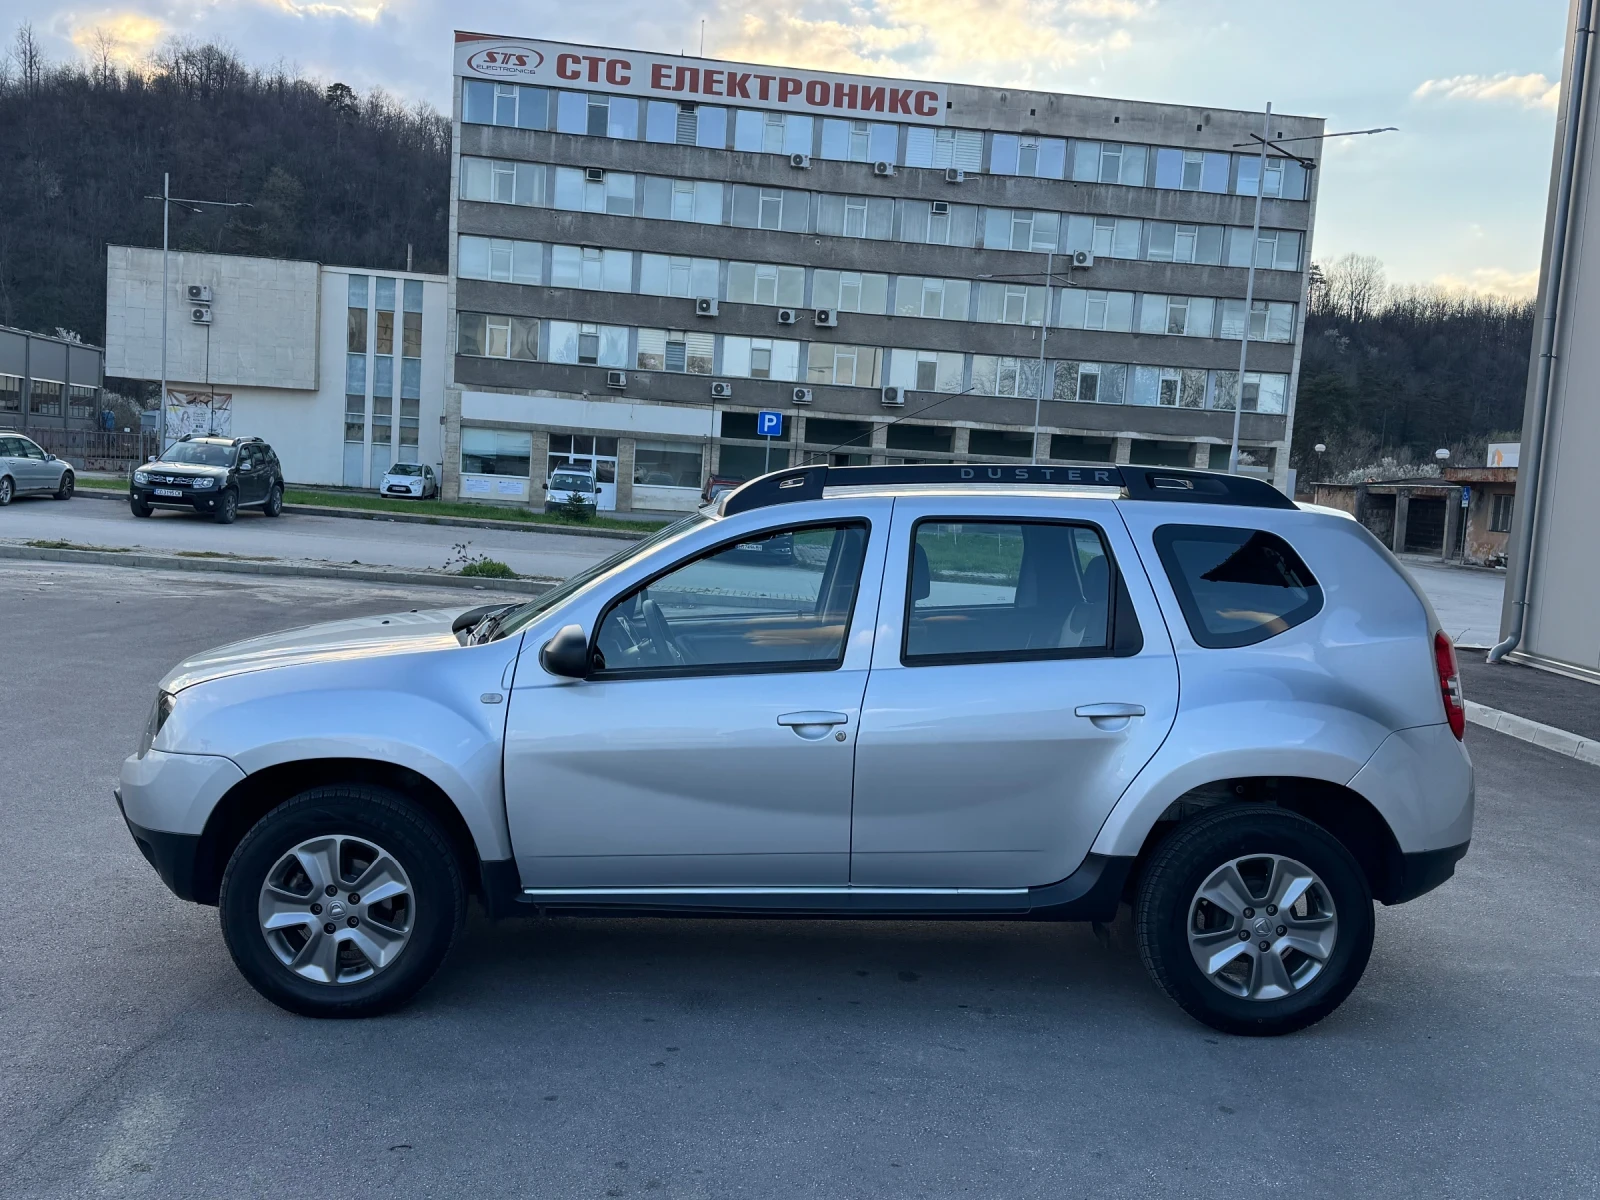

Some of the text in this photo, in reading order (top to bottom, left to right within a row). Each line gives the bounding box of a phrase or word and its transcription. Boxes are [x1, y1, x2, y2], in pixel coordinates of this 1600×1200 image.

[483, 51, 529, 66] STS
[476, 64, 536, 74] ELECTRONICS
[556, 53, 939, 117] СТС ЕЛЕКТРОНИКС
[764, 414, 777, 432] P
[960, 468, 1110, 482] DUSTER
